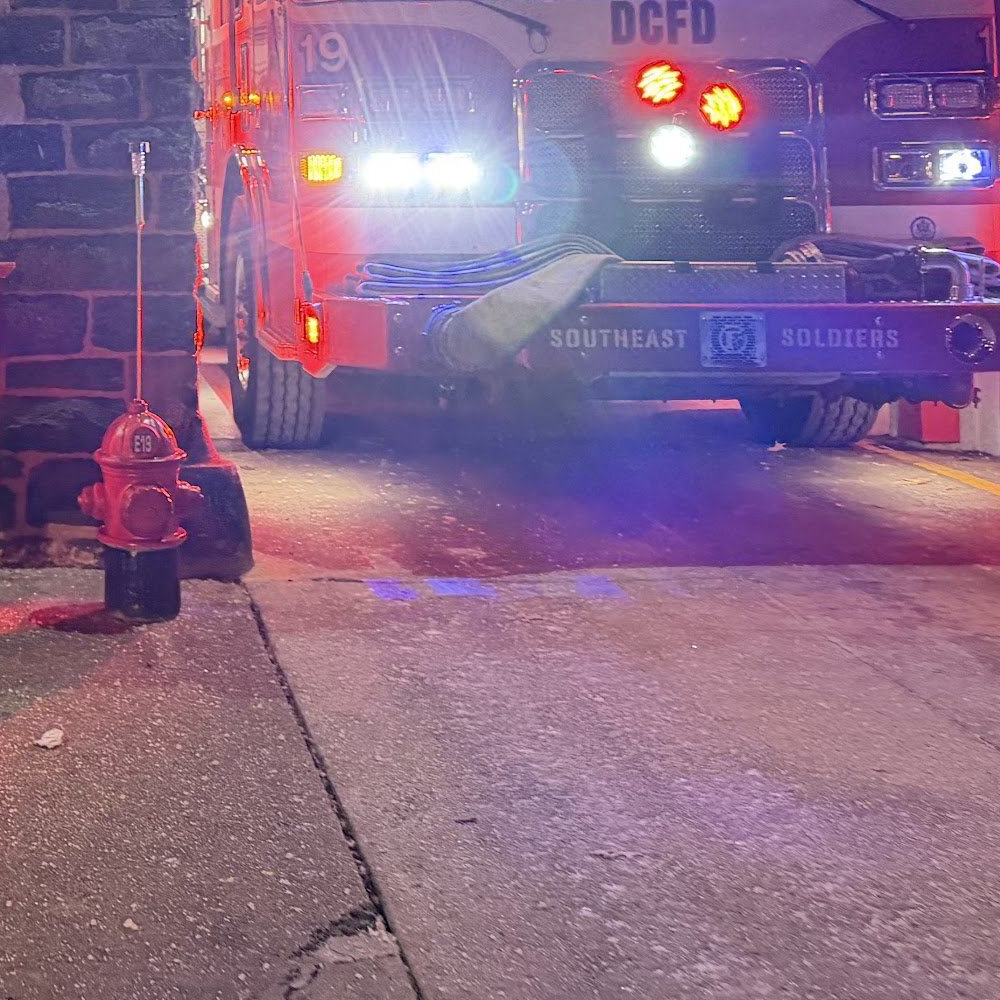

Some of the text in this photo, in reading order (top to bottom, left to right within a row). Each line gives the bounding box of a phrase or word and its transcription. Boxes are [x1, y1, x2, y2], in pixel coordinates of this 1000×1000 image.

[610, 0, 716, 45] DCFD
[301, 31, 348, 73] 19
[550, 328, 688, 349] SOUTHEAST
[781, 328, 899, 348] SOLDIERS
